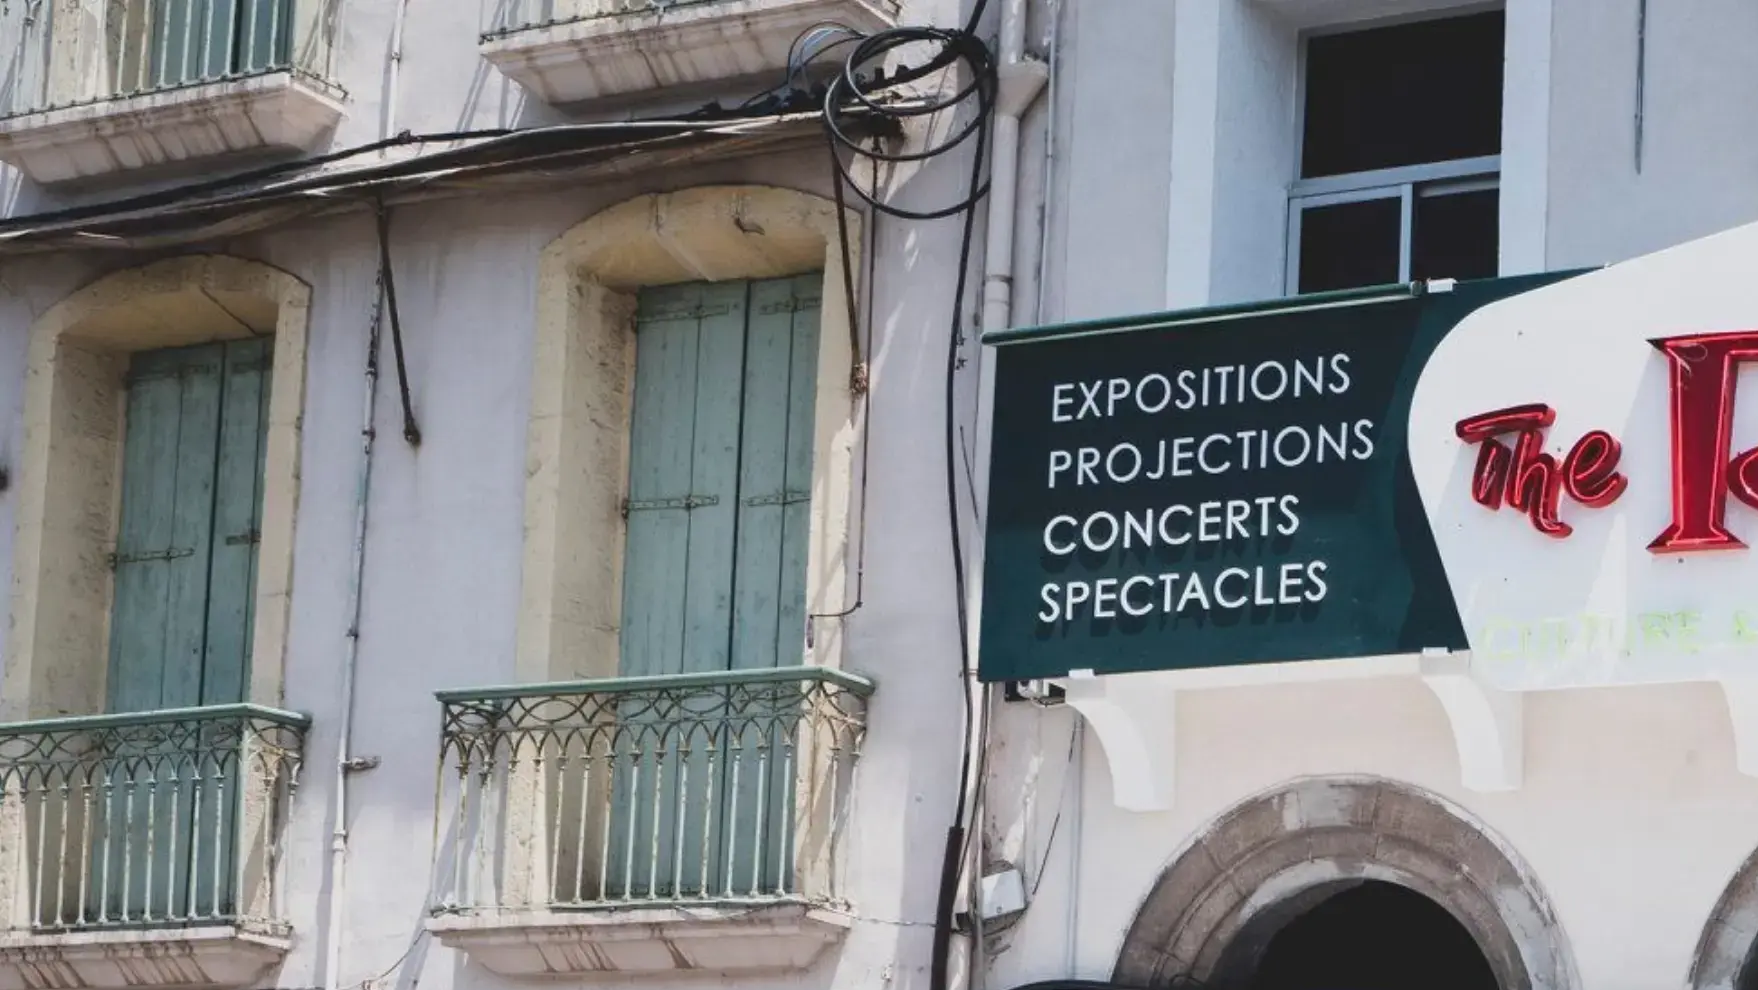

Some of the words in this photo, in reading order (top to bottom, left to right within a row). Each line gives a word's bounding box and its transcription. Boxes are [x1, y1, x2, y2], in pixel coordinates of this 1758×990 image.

[1050, 352, 1353, 424] EXPOSITIONS
[1047, 418, 1375, 489] PROJECTIONS
[1454, 401, 1629, 538] The
[1042, 493, 1301, 556] CONCERTS
[1037, 560, 1329, 624] SPECTACLES
